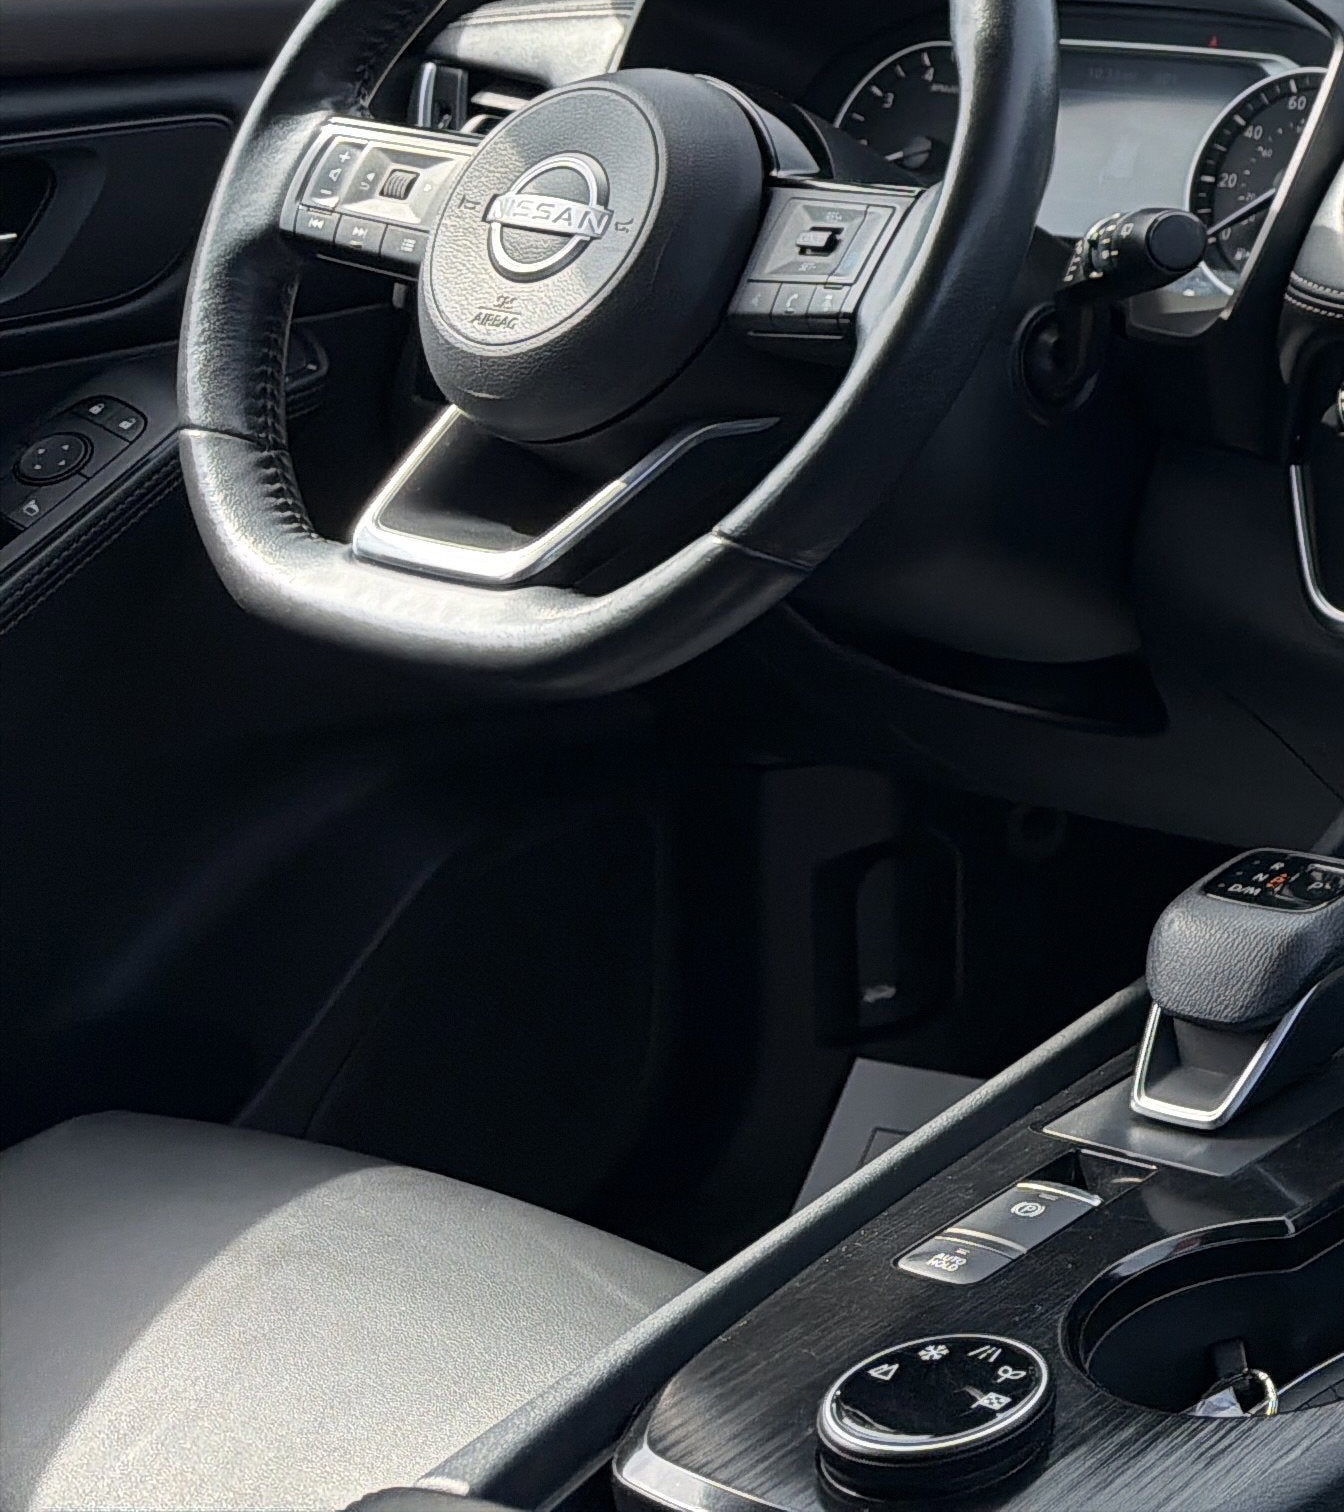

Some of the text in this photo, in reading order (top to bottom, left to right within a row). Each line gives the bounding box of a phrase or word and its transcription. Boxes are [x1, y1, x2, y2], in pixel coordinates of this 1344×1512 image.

[882, 92, 894, 108] 3
[1288, 95, 1307, 110] 60
[1244, 124, 1263, 139] 40
[1217, 173, 1237, 188] 20
[491, 196, 608, 235] NISSAN
[1220, 226, 1232, 239] 0
[1252, 872, 1270, 883] N
[926, 1258, 960, 1273] HOLD
[933, 1252, 967, 1266] AUTO
